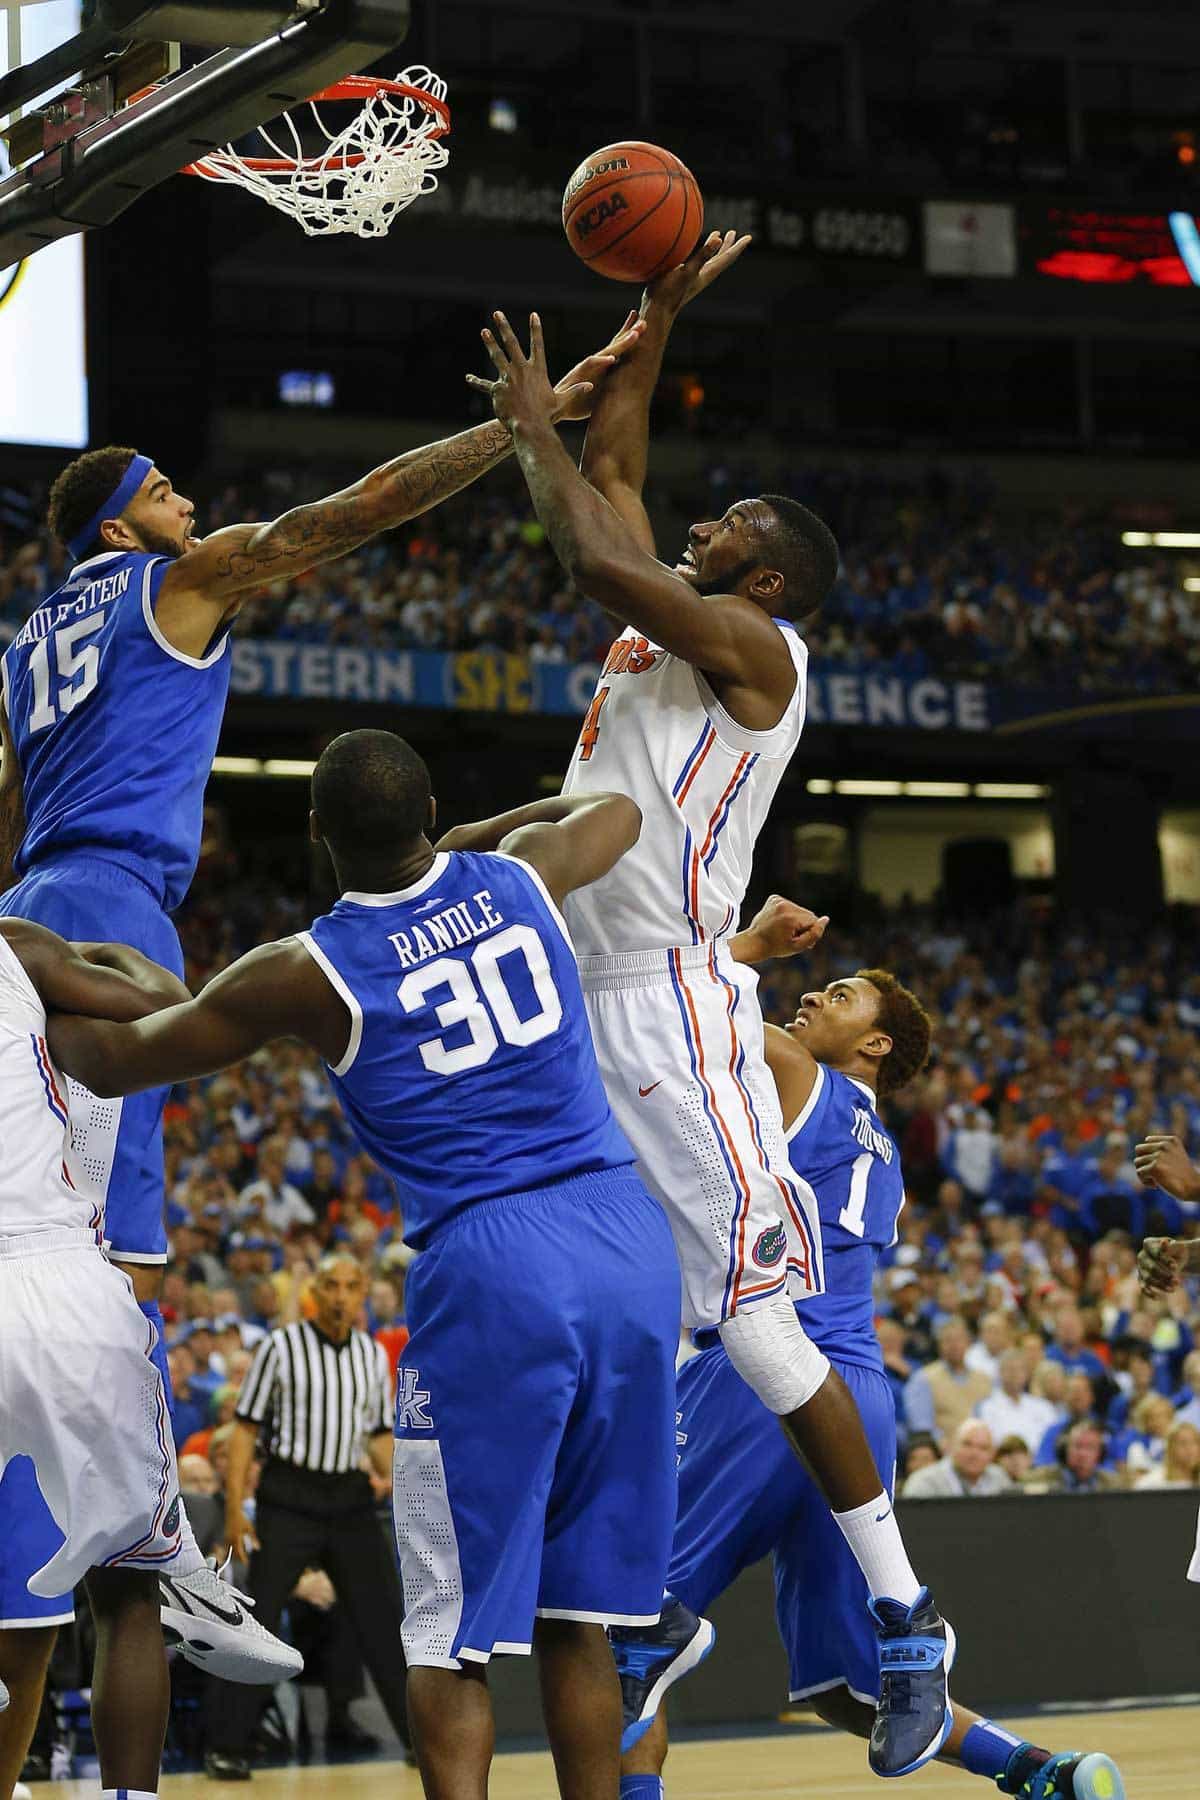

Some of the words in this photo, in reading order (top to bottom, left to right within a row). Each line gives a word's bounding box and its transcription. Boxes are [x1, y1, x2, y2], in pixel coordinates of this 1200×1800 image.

[575, 191, 629, 240] NCAA
[29, 610, 105, 734] 15
[387, 890, 504, 968] RANDLE
[396, 923, 564, 1076] 30
[850, 1105, 894, 1166] YOUNG
[838, 1151, 875, 1239] 1
